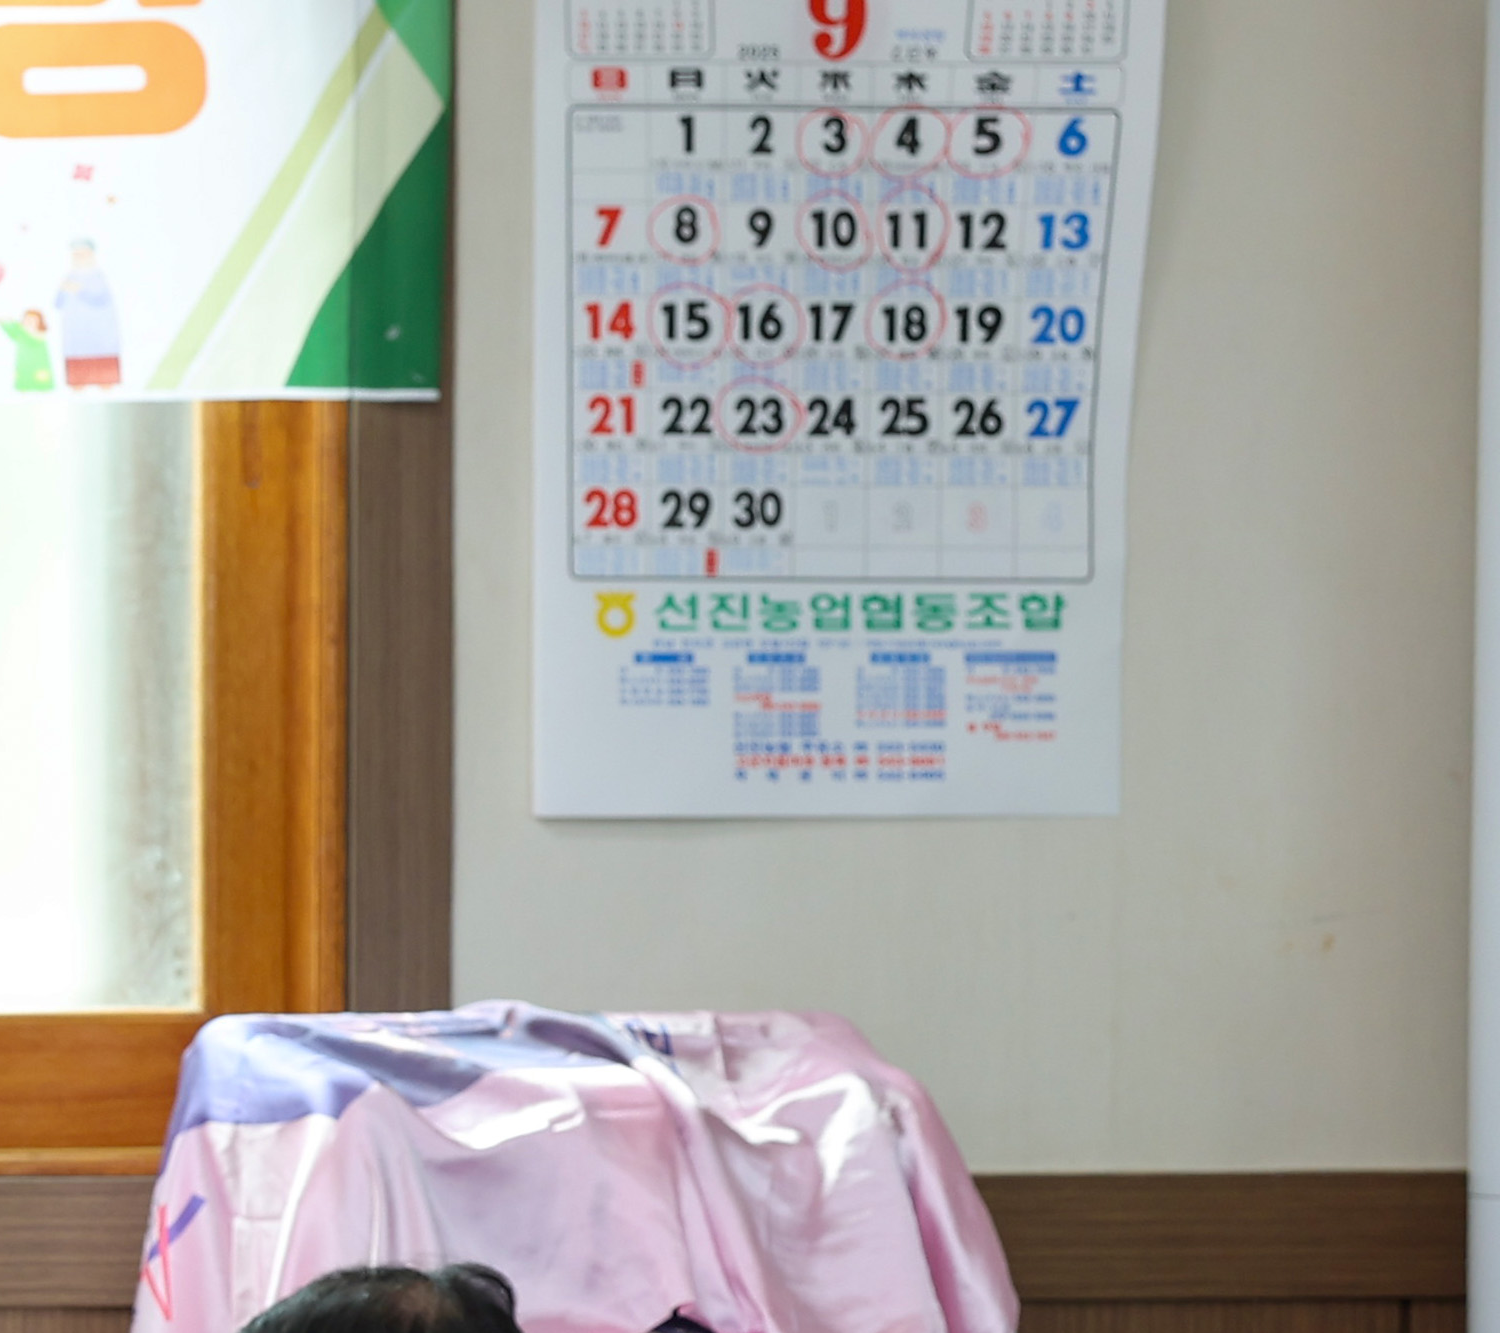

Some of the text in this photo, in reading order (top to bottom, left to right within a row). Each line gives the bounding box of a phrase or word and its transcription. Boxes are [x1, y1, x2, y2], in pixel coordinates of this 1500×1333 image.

[808, 0, 868, 61] 9
[680, 116, 1088, 157] 1 2 3 4 5 6
[595, 206, 1090, 251] 7 8 9 10 11 12 13
[584, 302, 1086, 344] 14 15 16 17 18 19 20
[589, 396, 1080, 438] 21 22 23 24 25 26 27
[583, 489, 638, 528] 28
[661, 490, 712, 529] 29
[733, 490, 782, 529] 30
[654, 592, 1066, 633] 선진농업협동조합
